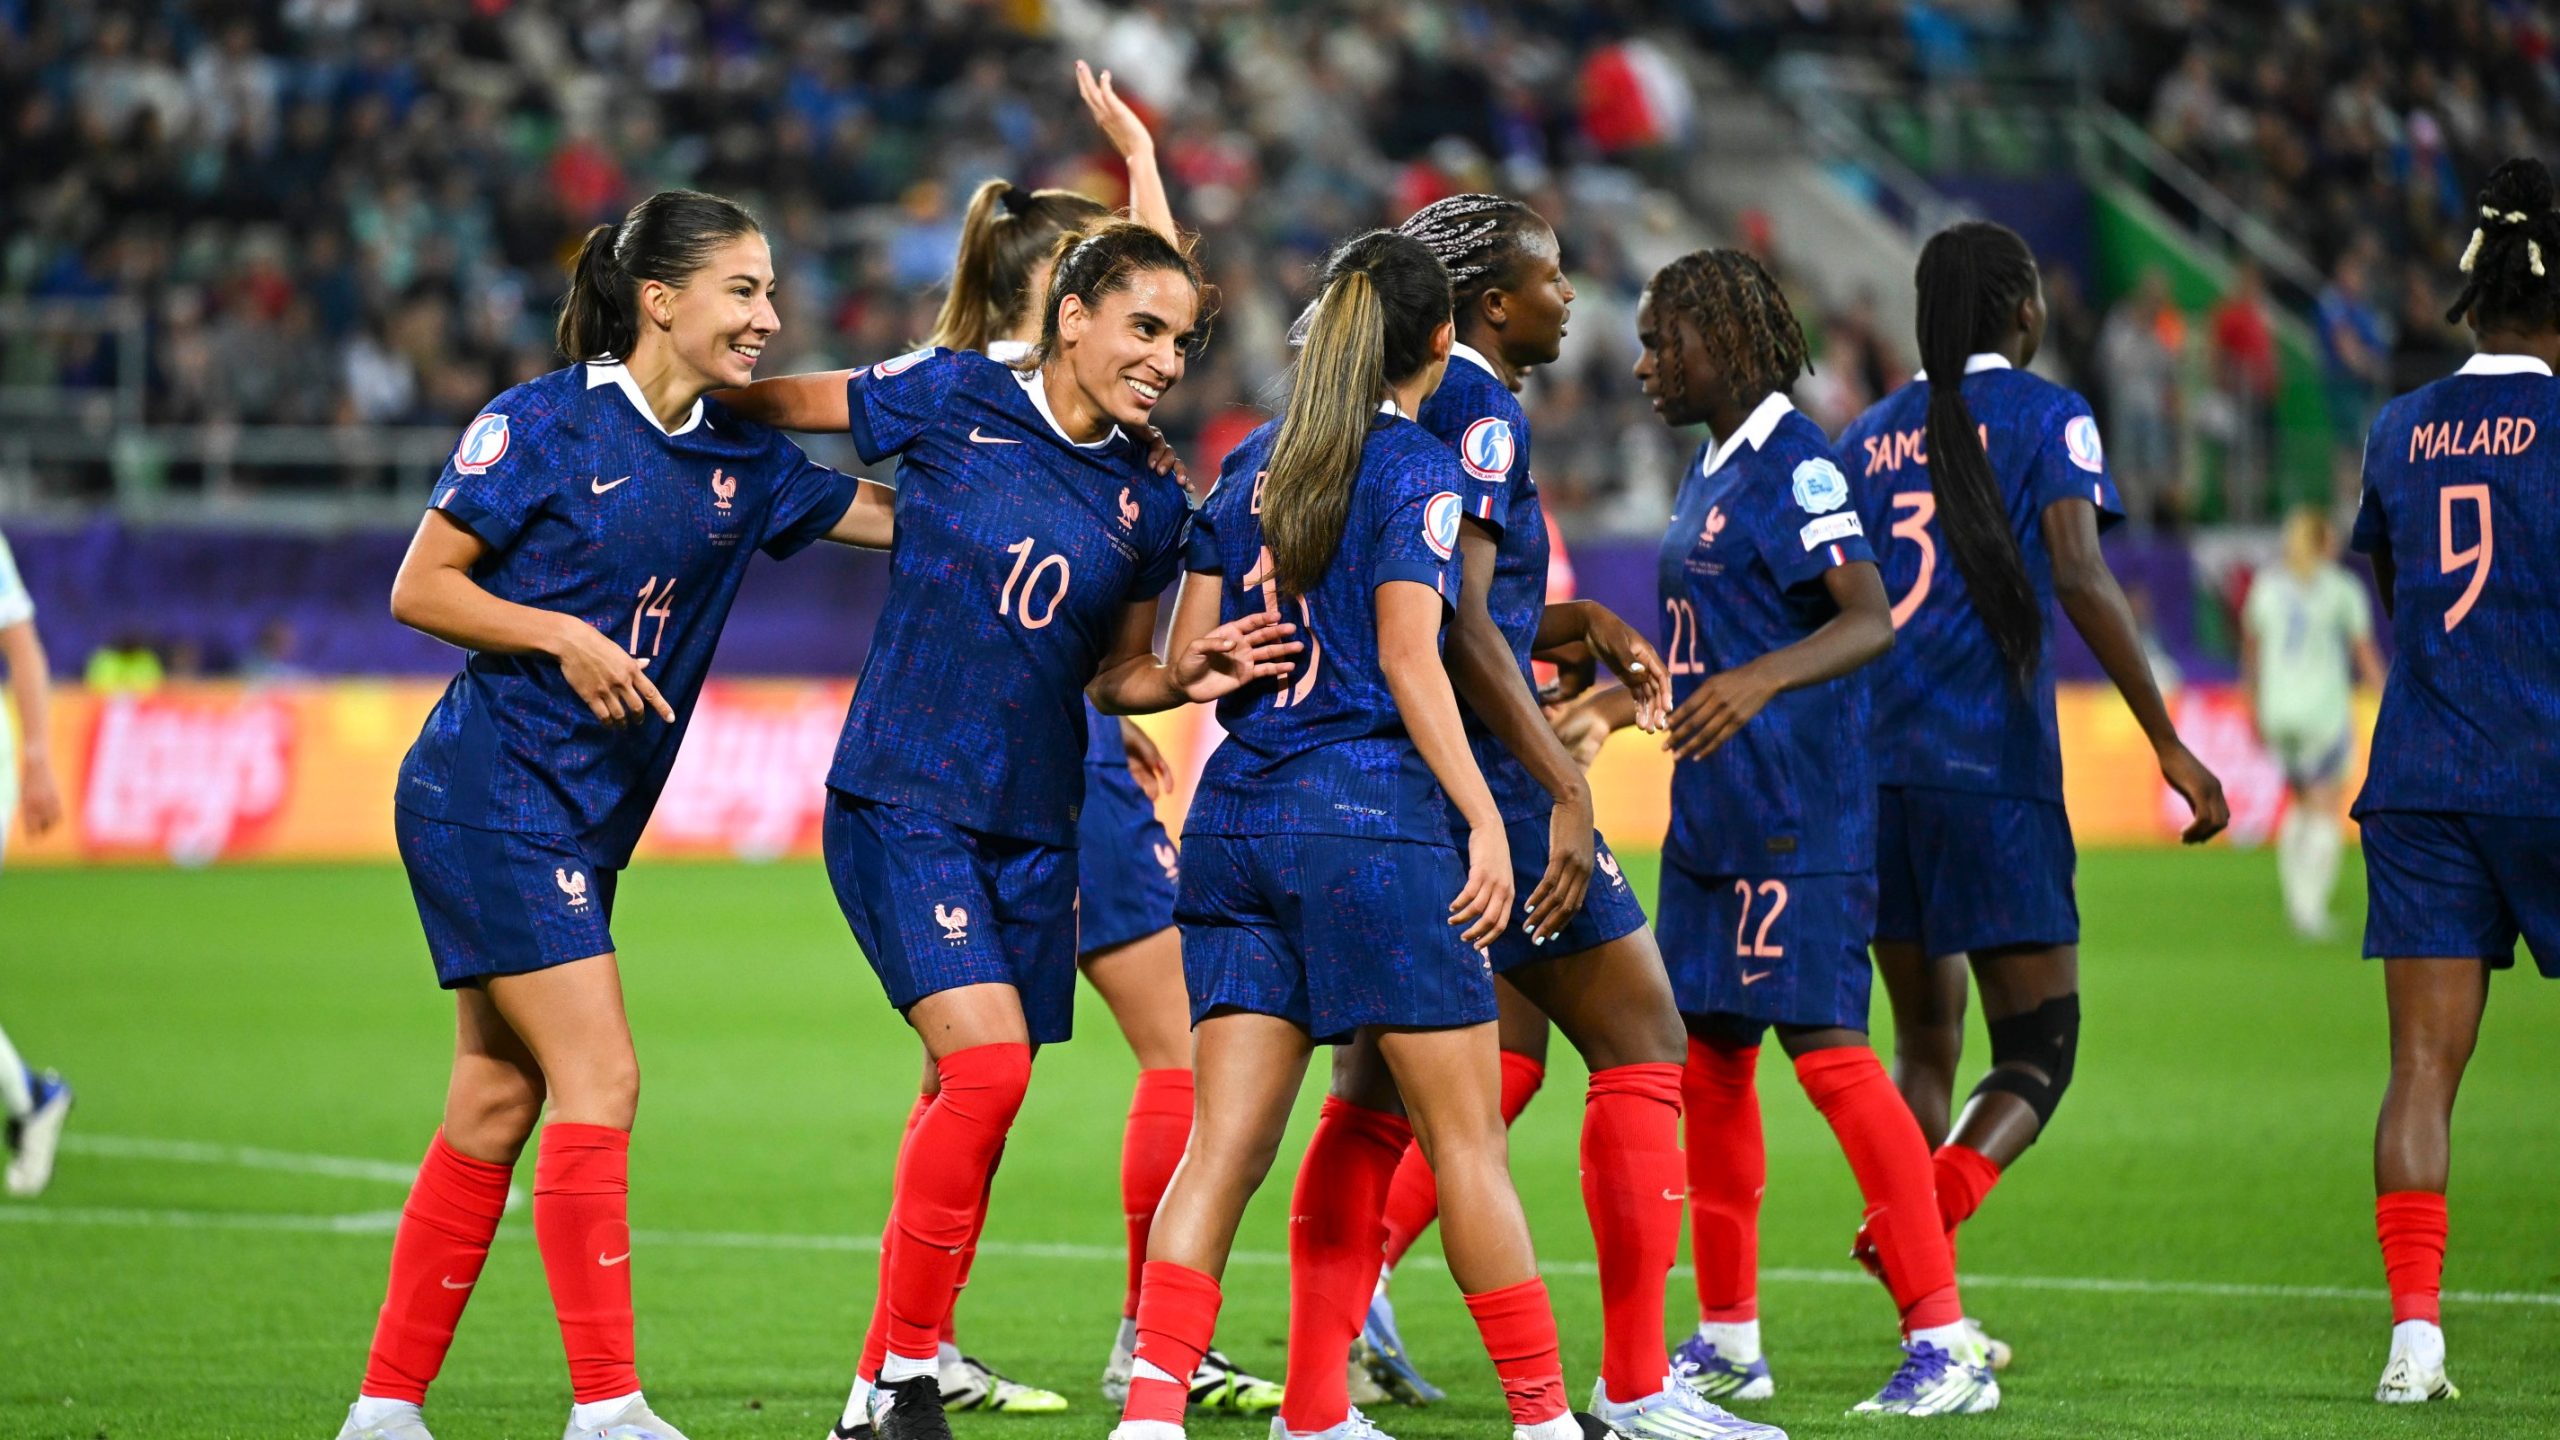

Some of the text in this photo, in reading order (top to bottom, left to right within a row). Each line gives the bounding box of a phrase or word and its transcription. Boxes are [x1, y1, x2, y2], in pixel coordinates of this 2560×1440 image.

[2408, 416, 2537, 464] MALARD
[998, 536, 1070, 630] 10
[1891, 491, 1936, 630] 3
[2439, 483, 2493, 634] 9
[629, 575, 677, 657] 14
[1666, 597, 1704, 674] 22
[1735, 879, 1788, 958] 22
